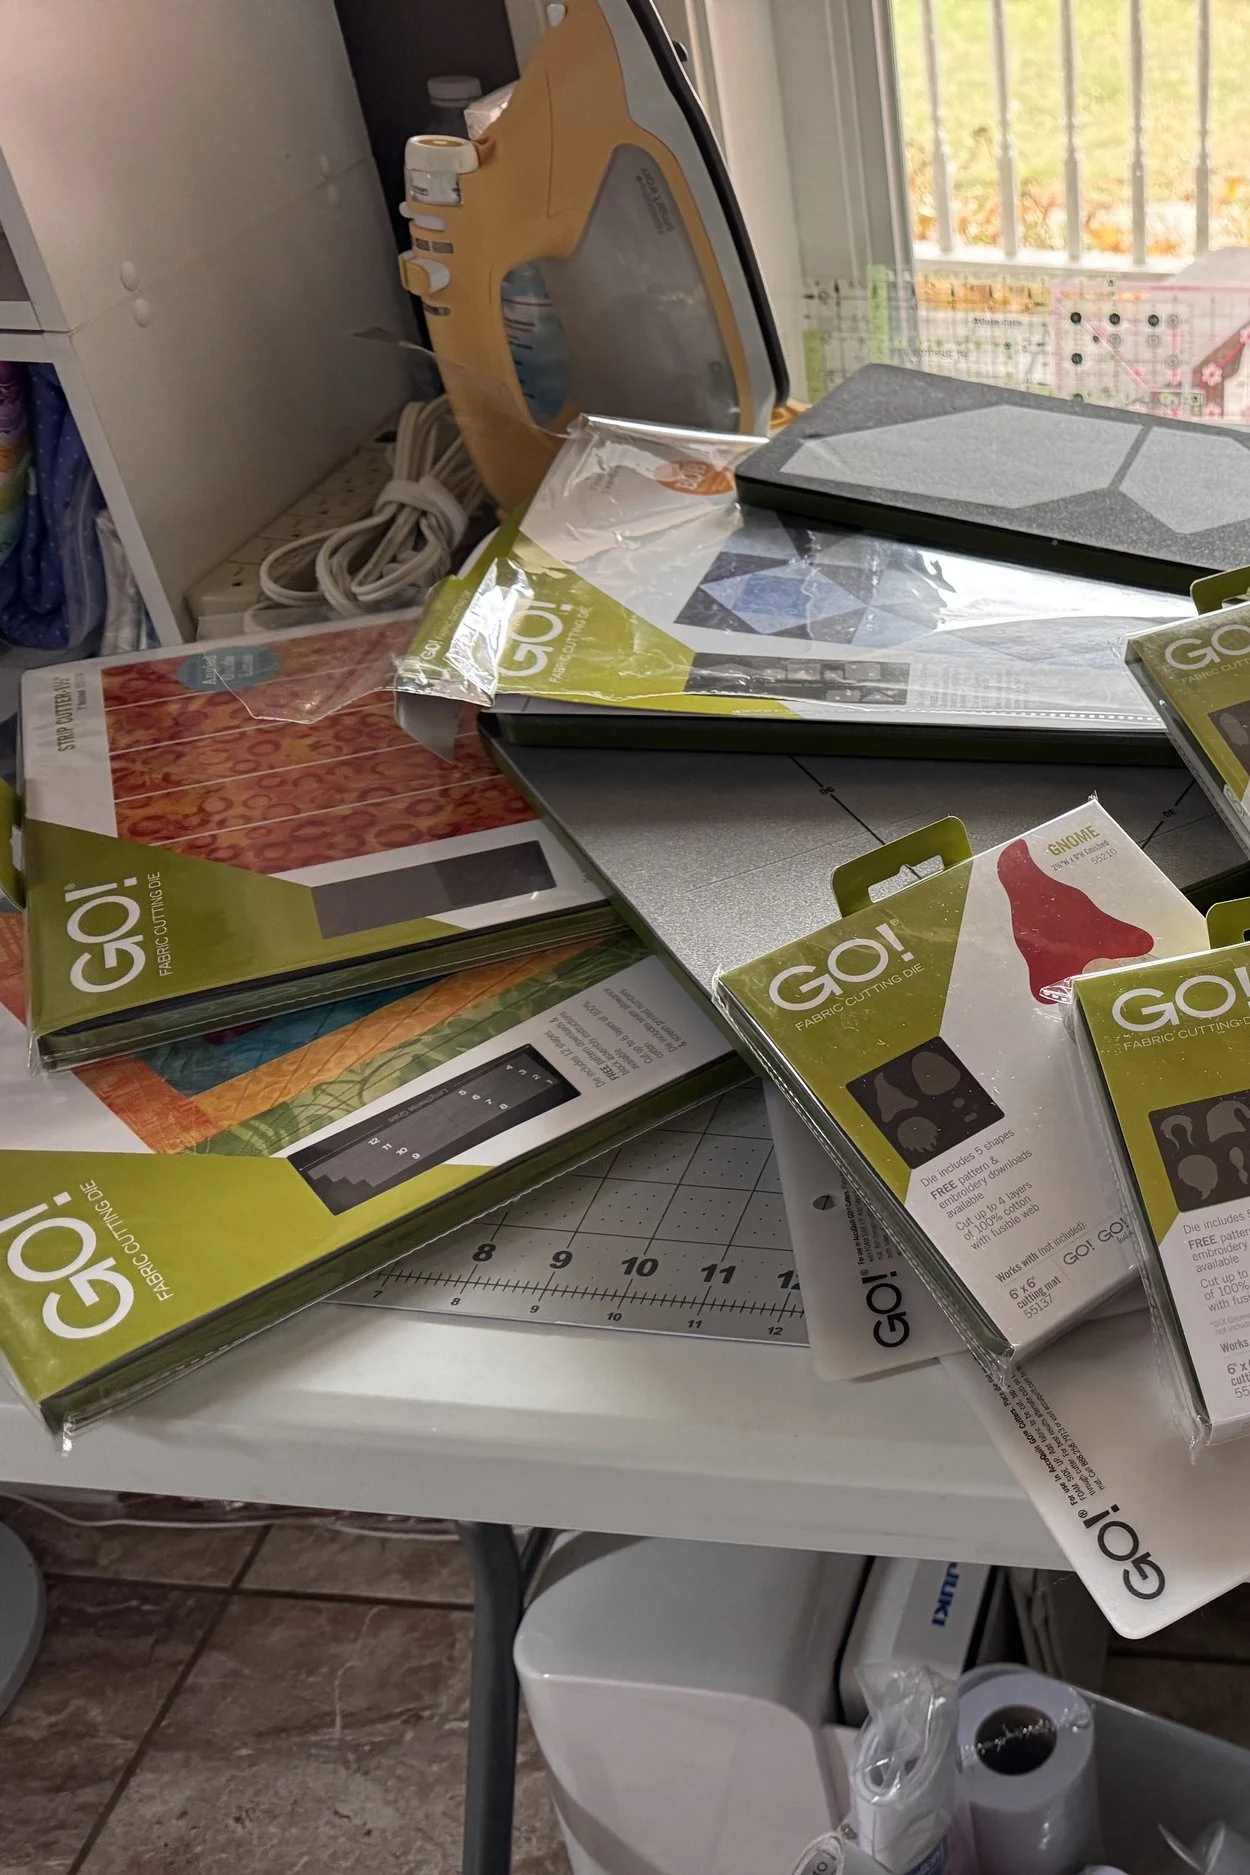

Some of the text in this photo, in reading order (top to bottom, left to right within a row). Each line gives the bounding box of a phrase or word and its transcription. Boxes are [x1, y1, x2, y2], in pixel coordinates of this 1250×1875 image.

[56, 727, 75, 751] STRIP
[1048, 826, 1100, 856] GNOME
[1090, 848, 1117, 864] 55210
[65, 877, 145, 993] GO!
[148, 871, 172, 976] FABRIC CUTTING DIE
[769, 923, 915, 1011] GO!
[795, 963, 925, 1031] FABRIC CUTTING DIE
[1124, 1033, 1174, 1050] FABRIC
[1178, 1020, 1239, 1039] CUTTING
[921, 1130, 1014, 1187] Die includes 5 shapes
[931, 1156, 1000, 1199] FREE pattern &
[939, 1150, 1032, 1209] embroidery downloads
[946, 1192, 984, 1218] available
[956, 1181, 1032, 1230] Cut up to 4 layers
[964, 1196, 1031, 1240] of 100% cotton
[1183, 1224, 1200, 1234] Die
[1204, 1212, 1245, 1230] includes
[80, 1180, 173, 1301] FABRIC CUTTING DIE
[971, 1203, 1039, 1250] with fusible web
[1188, 1235, 1217, 1250] FREE
[0, 1192, 134, 1339] GO!
[473, 1243, 736, 1284] 8 9 10 11
[1192, 1243, 1247, 1261] embroidery
[1196, 1255, 1239, 1272] available
[1017, 1276, 1061, 1309] cutting mat
[1020, 1285, 1028, 1294] x
[1200, 1278, 1219, 1288] Cut
[1223, 1274, 1235, 1284] up
[1238, 1270, 1248, 1279] to
[1205, 1290, 1215, 1300] of
[1218, 1281, 1249, 1296] 100%
[862, 1271, 910, 1347] GO!
[1023, 1294, 1053, 1319] 55137
[1208, 1301, 1229, 1311] with
[1220, 1340, 1249, 1353] Works
[1240, 1362, 1247, 1371] x
[1034, 1445, 1078, 1506] For use in AccuQuilt
[1083, 1504, 1165, 1599] GO!
[932, 1562, 959, 1626] JUKI
